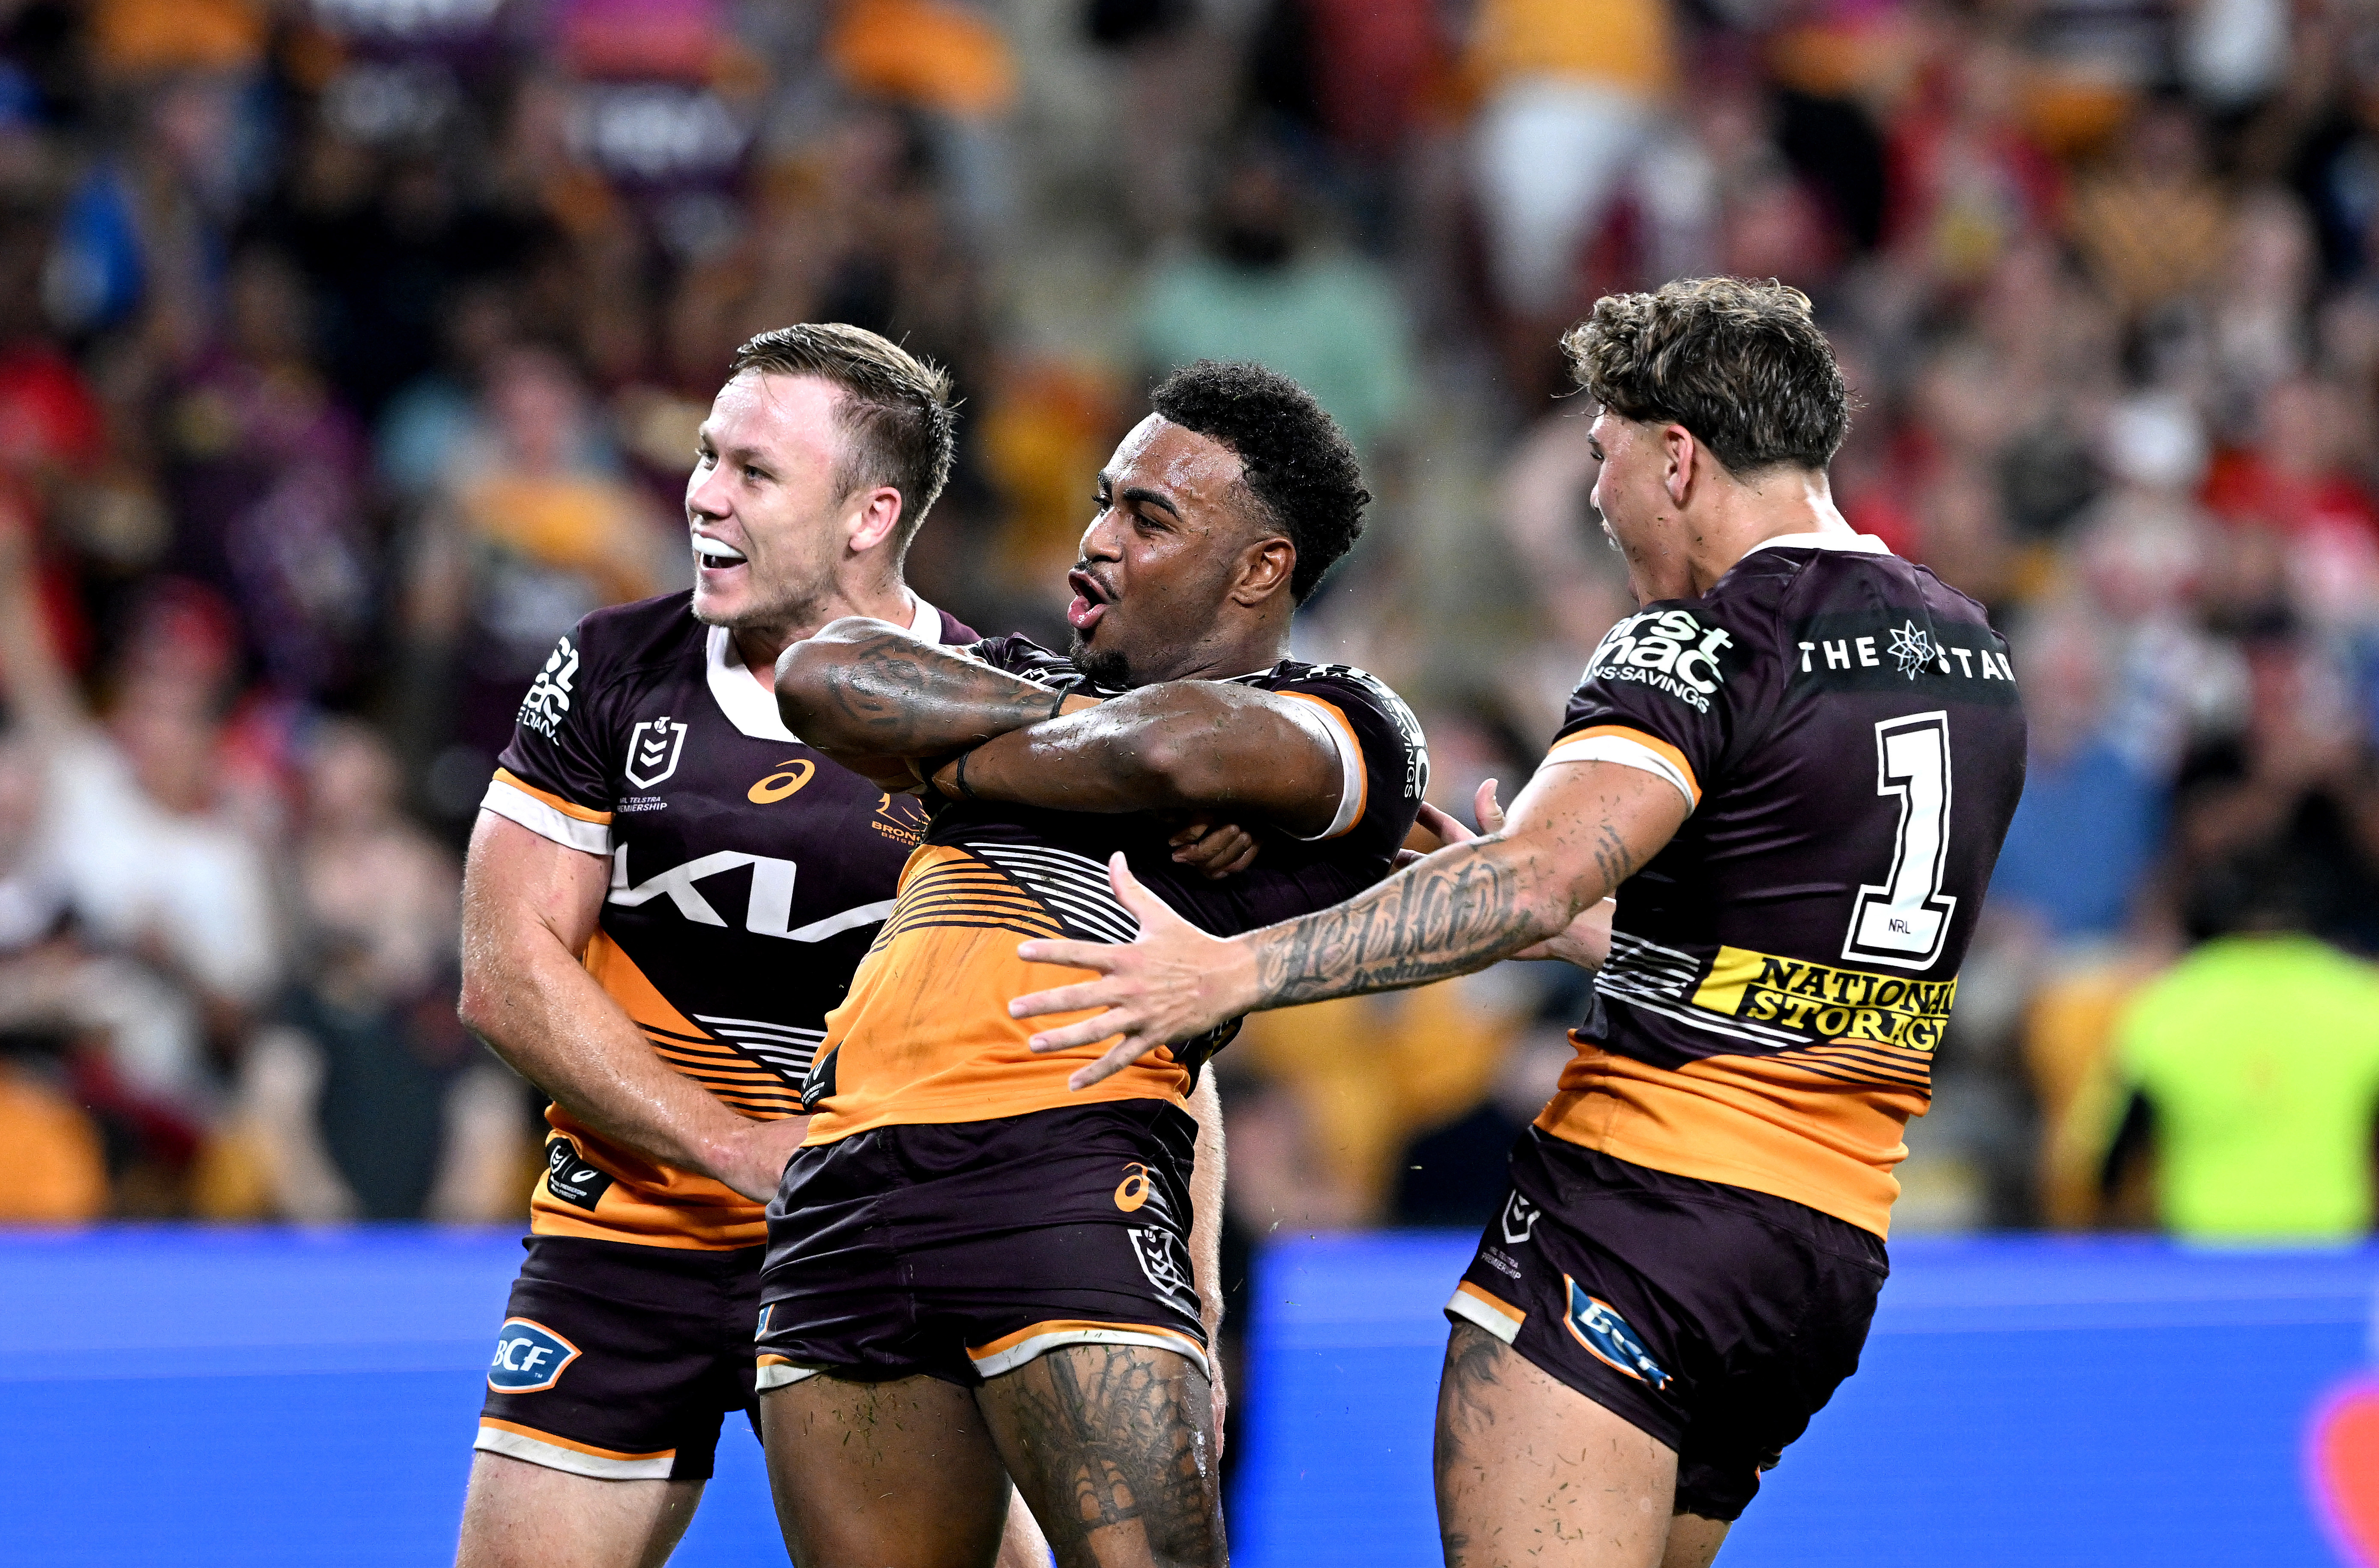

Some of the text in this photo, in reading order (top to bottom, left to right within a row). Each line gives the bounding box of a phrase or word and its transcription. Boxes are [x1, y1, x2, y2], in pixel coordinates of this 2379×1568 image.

[1799, 636, 1880, 672] THE
[1841, 710, 1957, 971] 1
[1888, 917, 1911, 935] NRL
[491, 1337, 553, 1371] BCF
